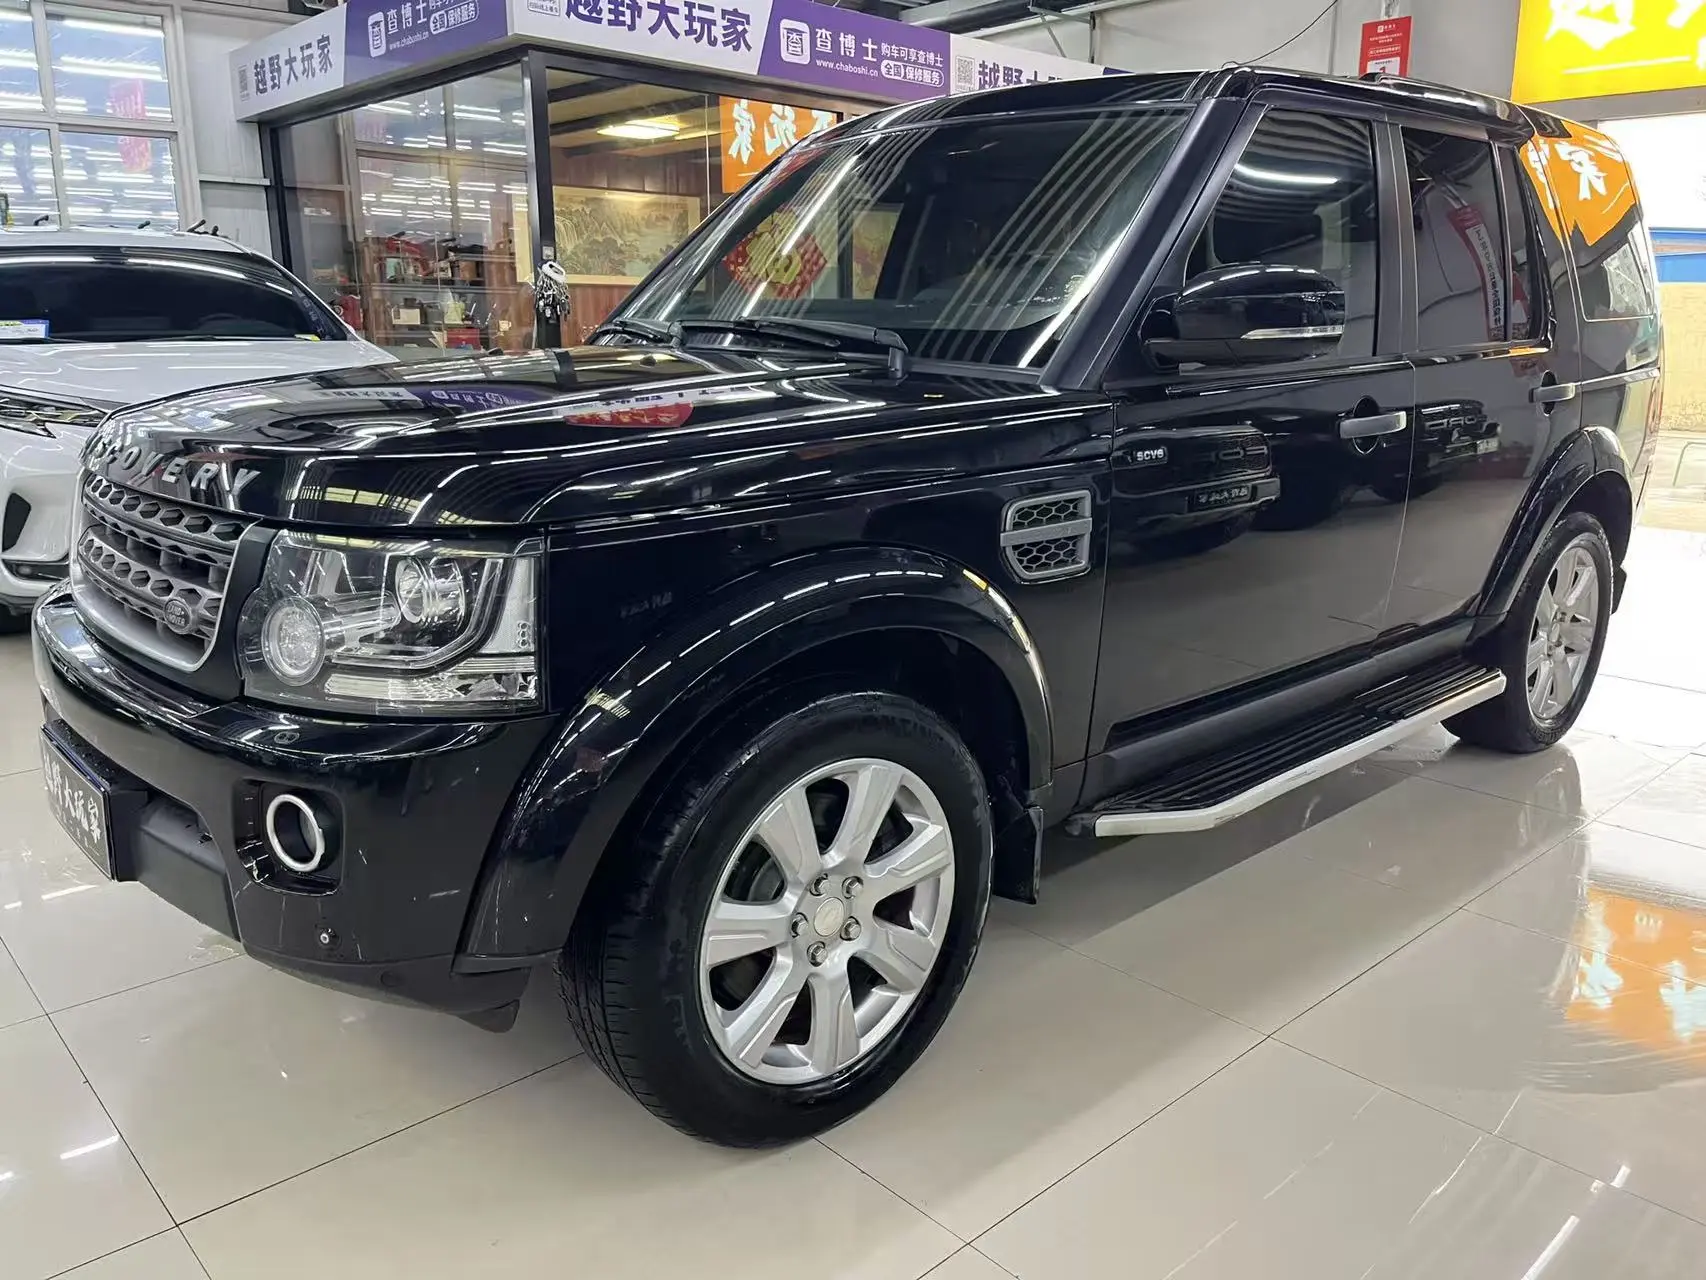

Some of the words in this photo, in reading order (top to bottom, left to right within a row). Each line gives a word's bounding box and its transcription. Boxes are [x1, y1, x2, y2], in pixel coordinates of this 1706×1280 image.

[386, 2, 427, 34] 查博士
[815, 28, 878, 62] 查博士
[881, 42, 943, 67] 购车可享查博士
[253, 34, 333, 96] 越野大玩家
[815, 58, 879, 77] www.chaboshi.cn
[978, 60, 1063, 89] 越野
